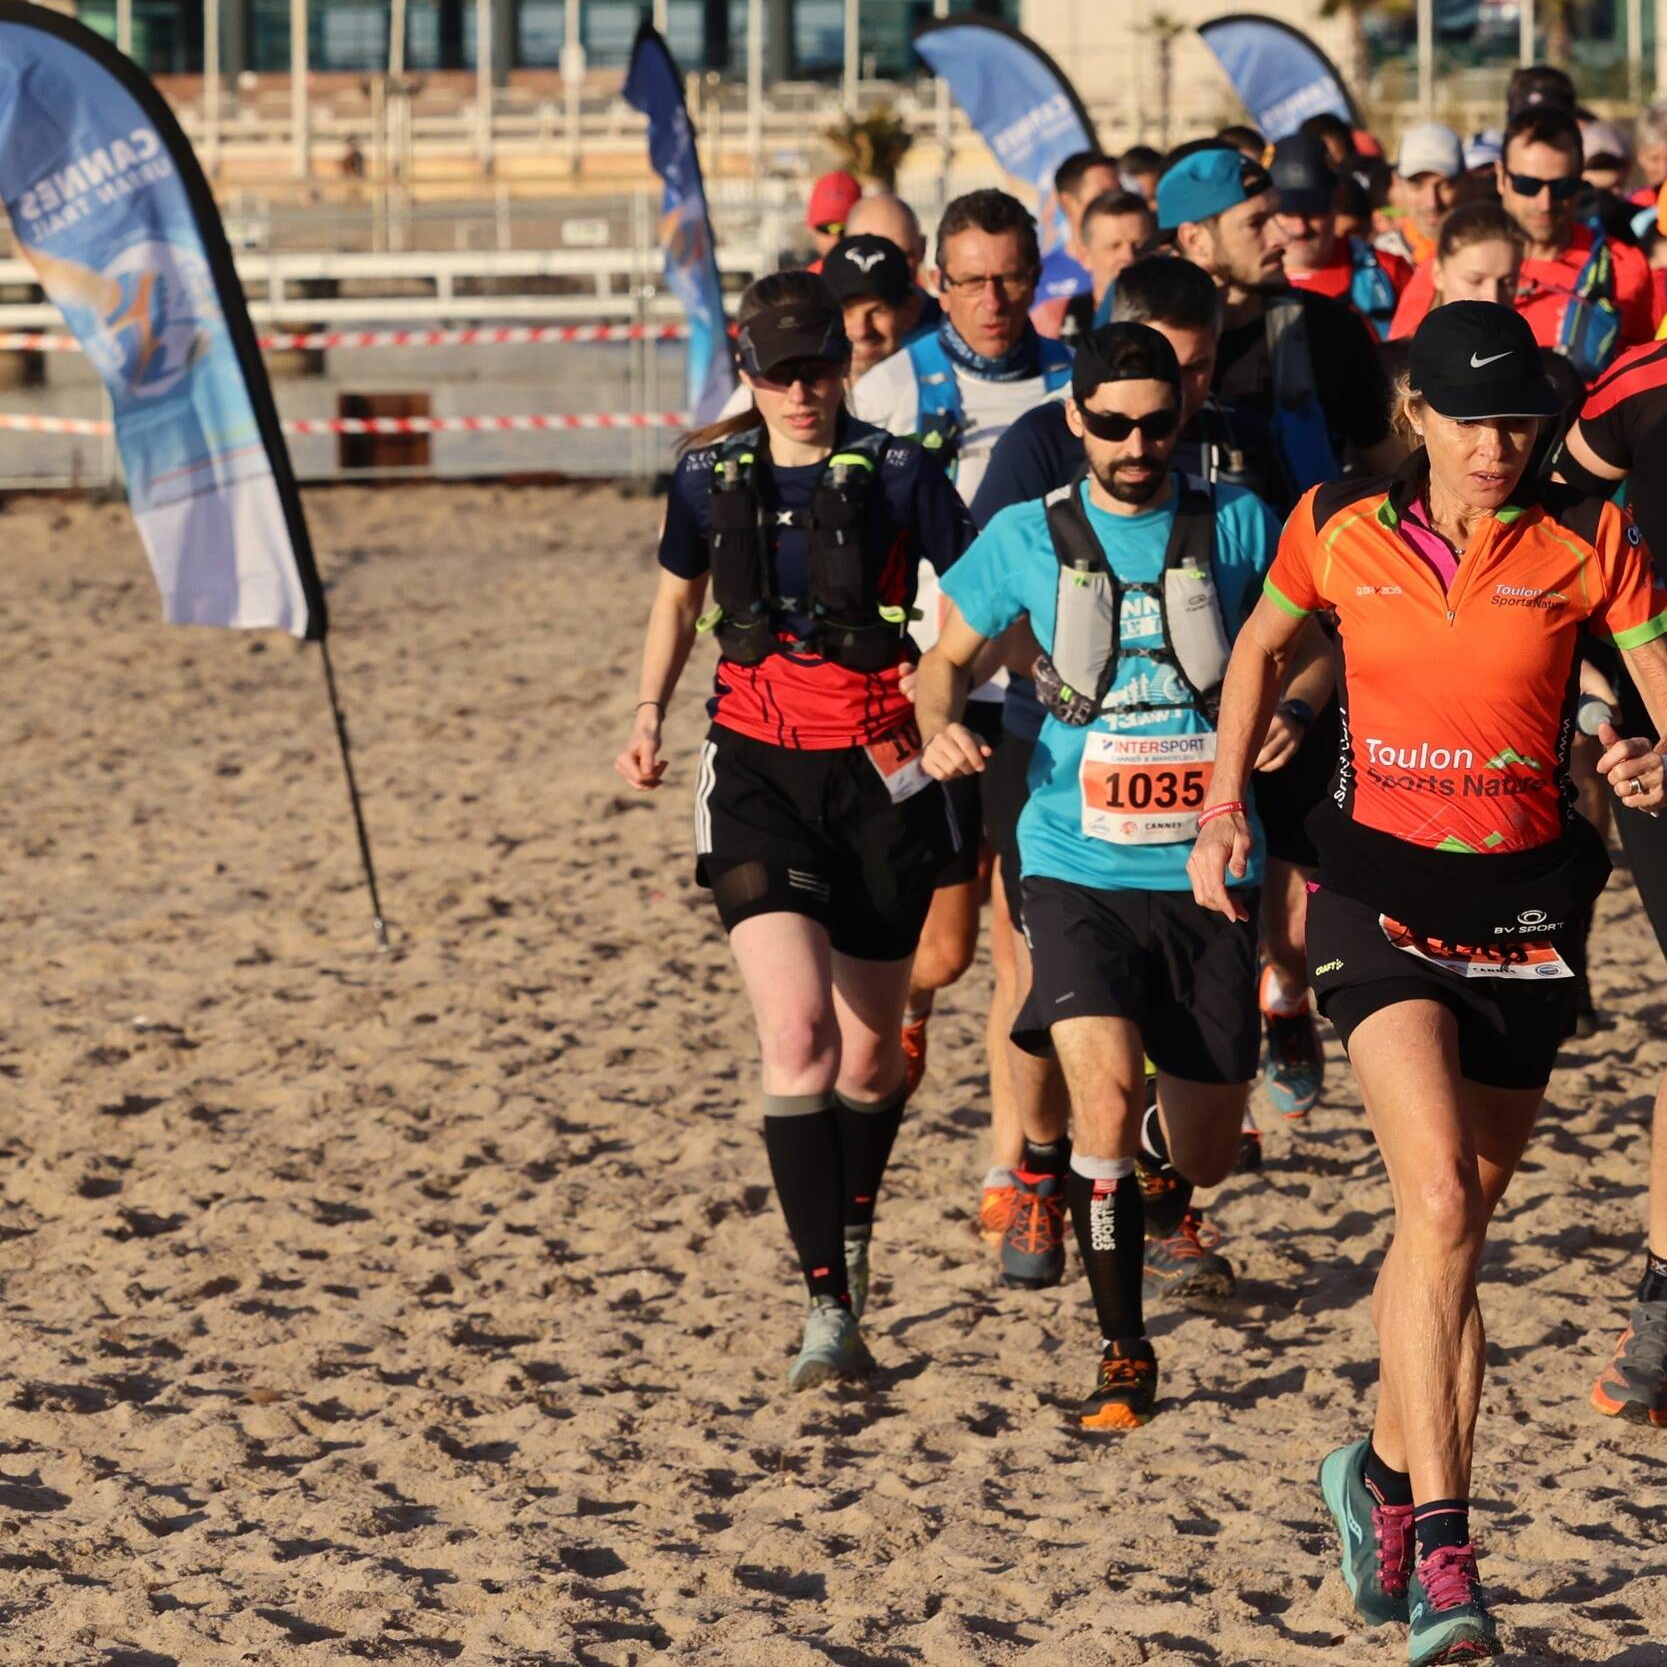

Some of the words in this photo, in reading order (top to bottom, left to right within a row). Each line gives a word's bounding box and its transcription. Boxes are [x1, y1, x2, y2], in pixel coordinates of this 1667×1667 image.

[1494, 584, 1542, 597] Toulon
[1114, 738, 1206, 754] INTERSPORT
[1365, 738, 1473, 770] Toulon
[1105, 770, 1205, 810] 1035
[1366, 768, 1455, 797] Sports
[1463, 774, 1547, 797] Nature
[1519, 921, 1565, 933] SPORT
[1315, 961, 1337, 976] CRAFT
